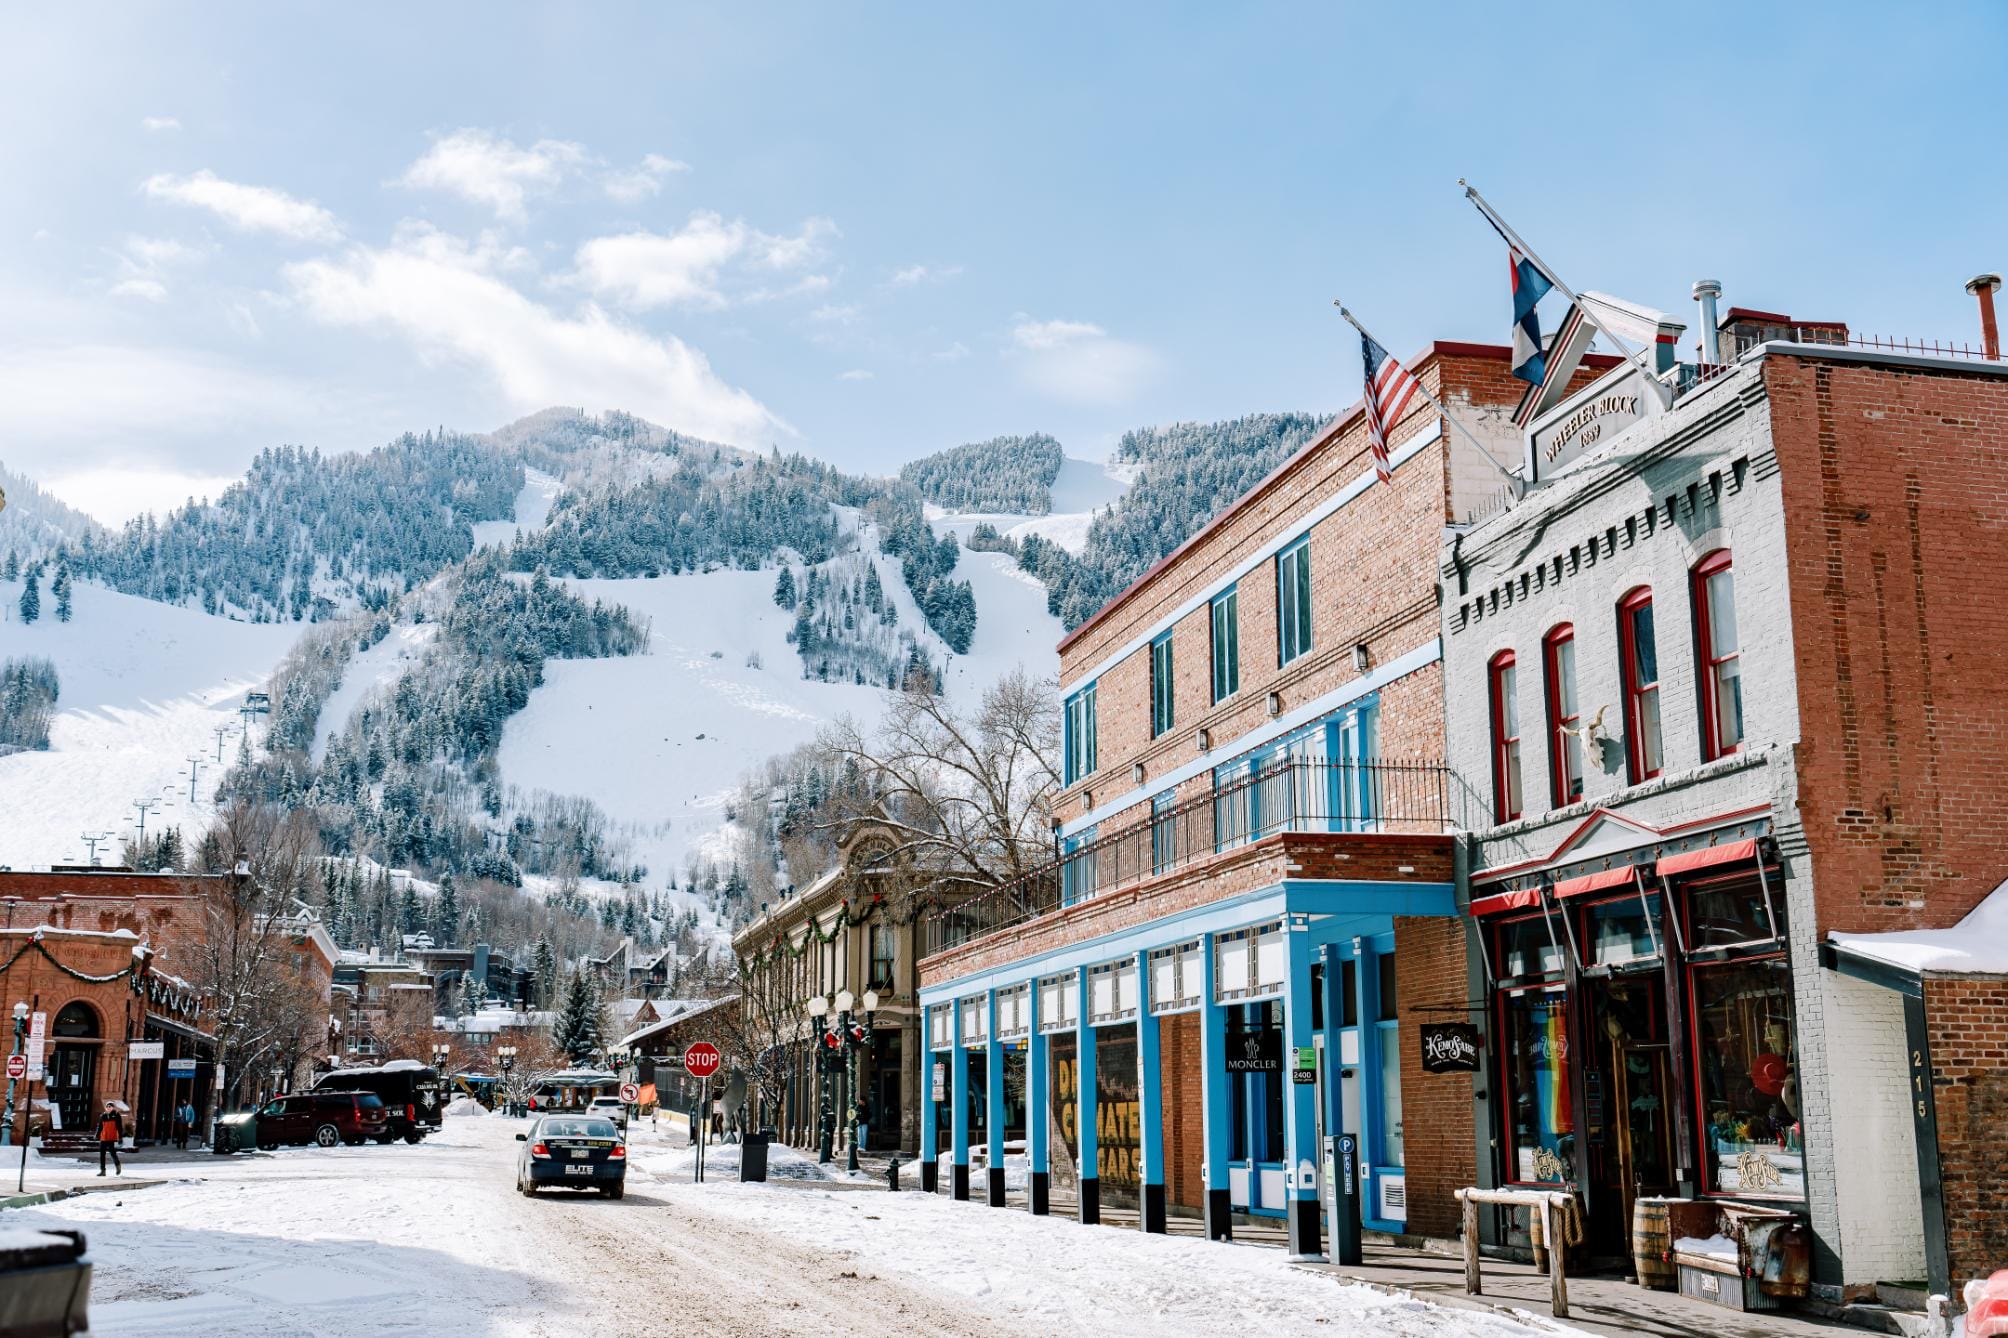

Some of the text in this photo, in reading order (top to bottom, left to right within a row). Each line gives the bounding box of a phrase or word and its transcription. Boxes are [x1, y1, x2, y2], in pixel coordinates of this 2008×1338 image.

[1545, 395, 1638, 463] WHEELER BLOCK
[1579, 424, 1601, 448] 1889
[130, 1047, 162, 1055] MARCUS
[687, 1053, 718, 1066] STOP
[1228, 1060, 1277, 1069] MONCLER
[1294, 1071, 1312, 1079] 2400
